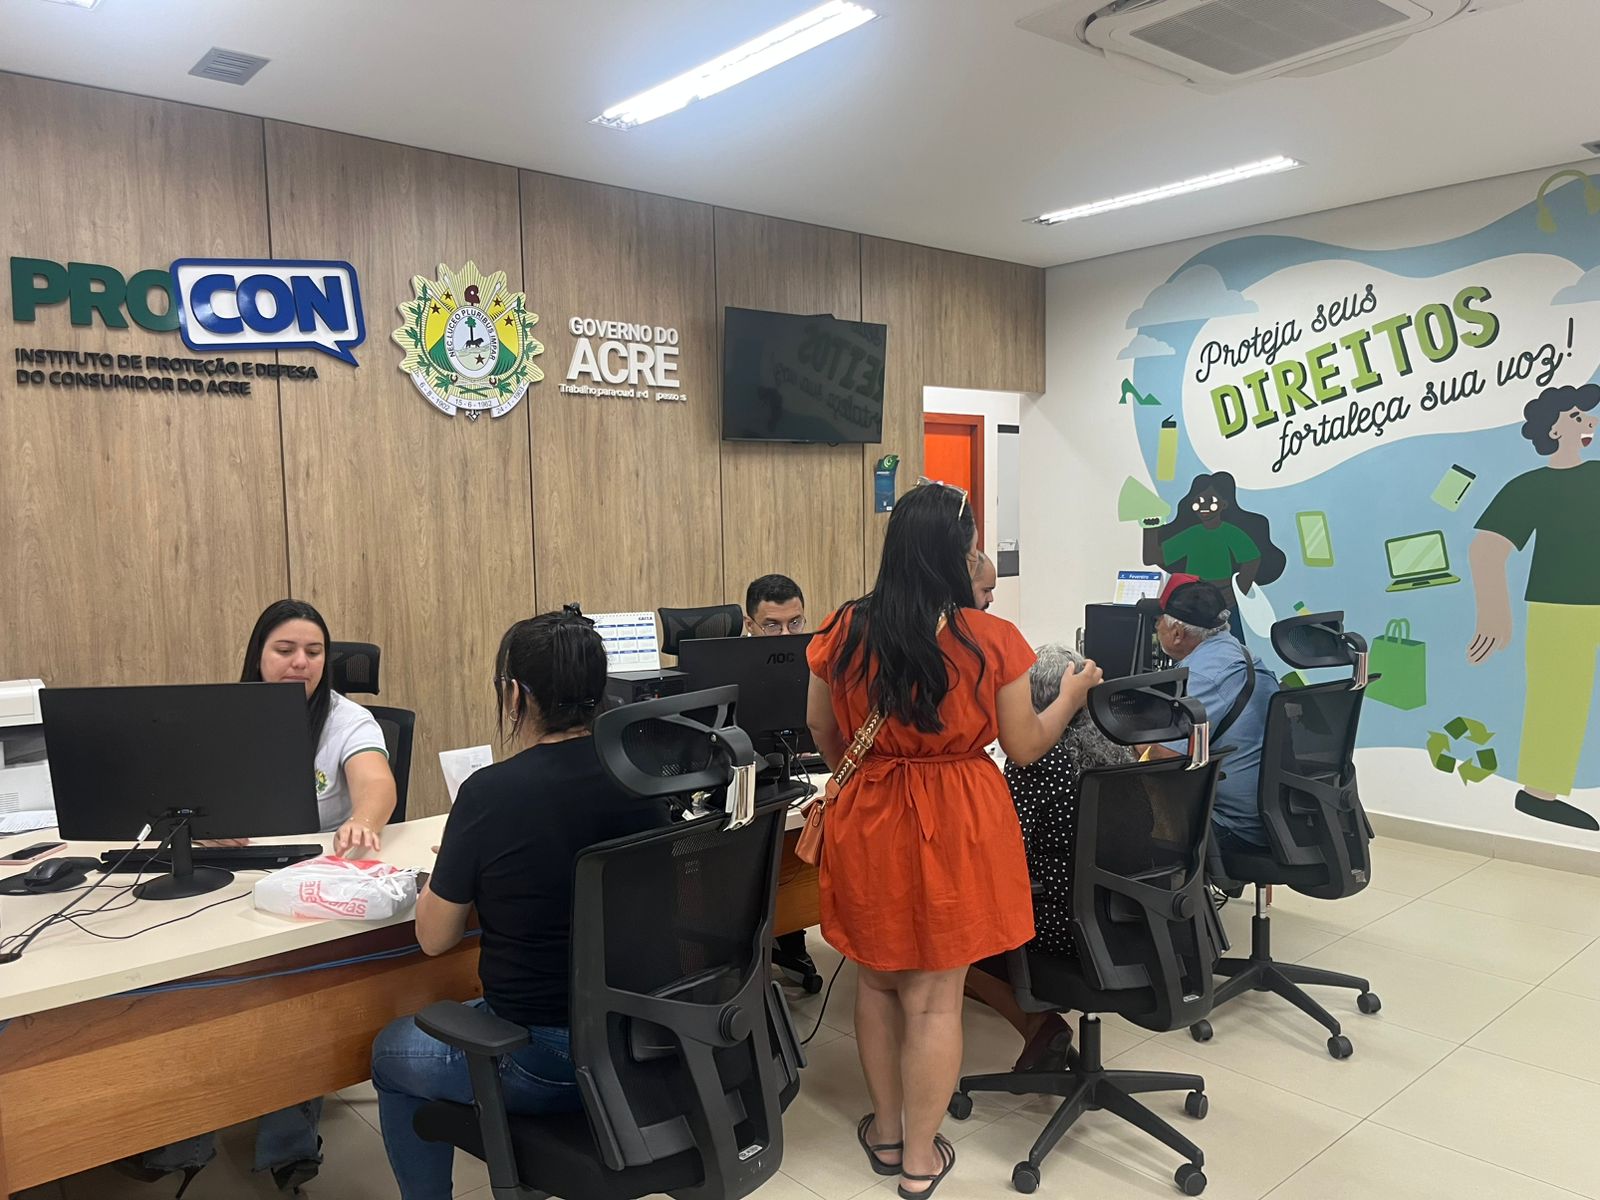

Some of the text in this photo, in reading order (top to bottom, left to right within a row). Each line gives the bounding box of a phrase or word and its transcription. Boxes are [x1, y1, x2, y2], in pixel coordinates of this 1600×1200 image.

[460, 309, 495, 334] PLURIBUS
[569, 316, 679, 345] GOVERNO DO
[1195, 283, 1378, 383] Proteja seus
[15, 348, 319, 379] INSTITUTO DE PROTEÇÃO E DEFESA
[566, 337, 681, 388] ACRE
[1209, 285, 1501, 440] DIREITOS
[16, 369, 251, 395] DO CONSUMIDOR DO ACRE
[1272, 391, 1411, 473] fortaleça
[1420, 368, 1486, 411] sua
[766, 652, 795, 664] AOC
